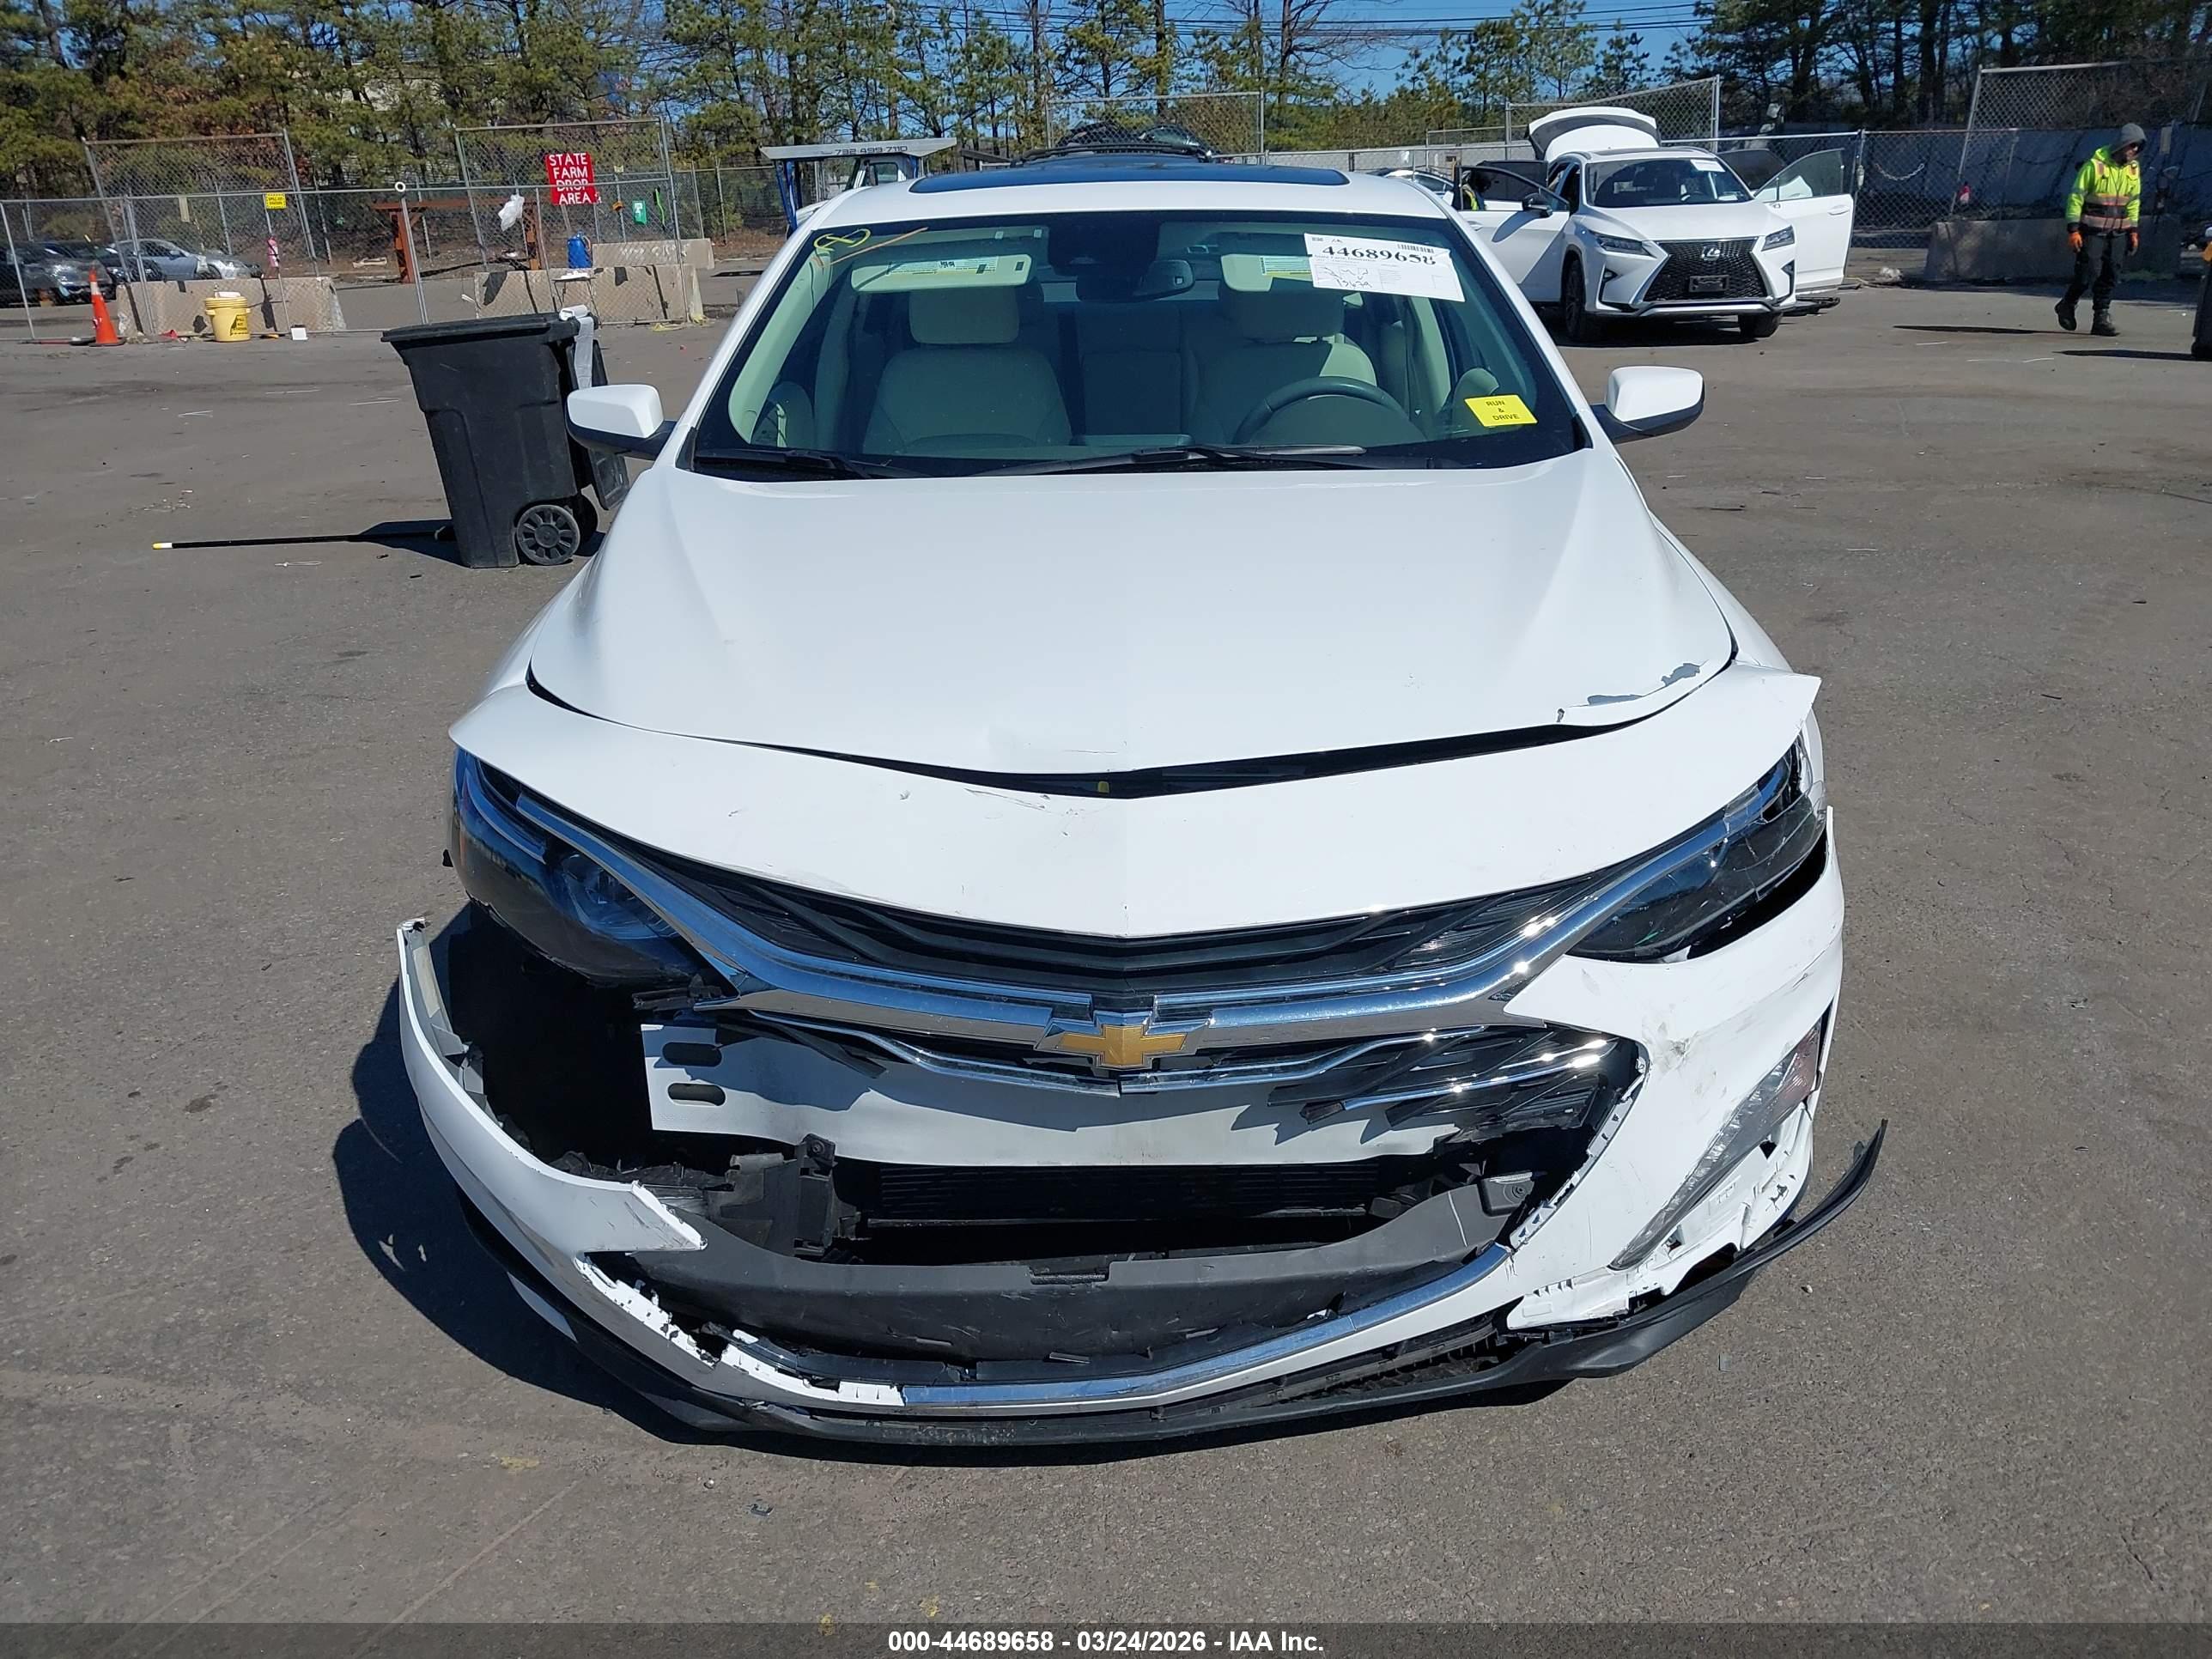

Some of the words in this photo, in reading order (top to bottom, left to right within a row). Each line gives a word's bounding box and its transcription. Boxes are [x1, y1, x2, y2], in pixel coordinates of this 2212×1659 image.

[549, 153, 588, 167] STATE
[552, 166, 589, 179] FARM
[556, 179, 589, 192] DROP
[558, 191, 592, 205] AREA
